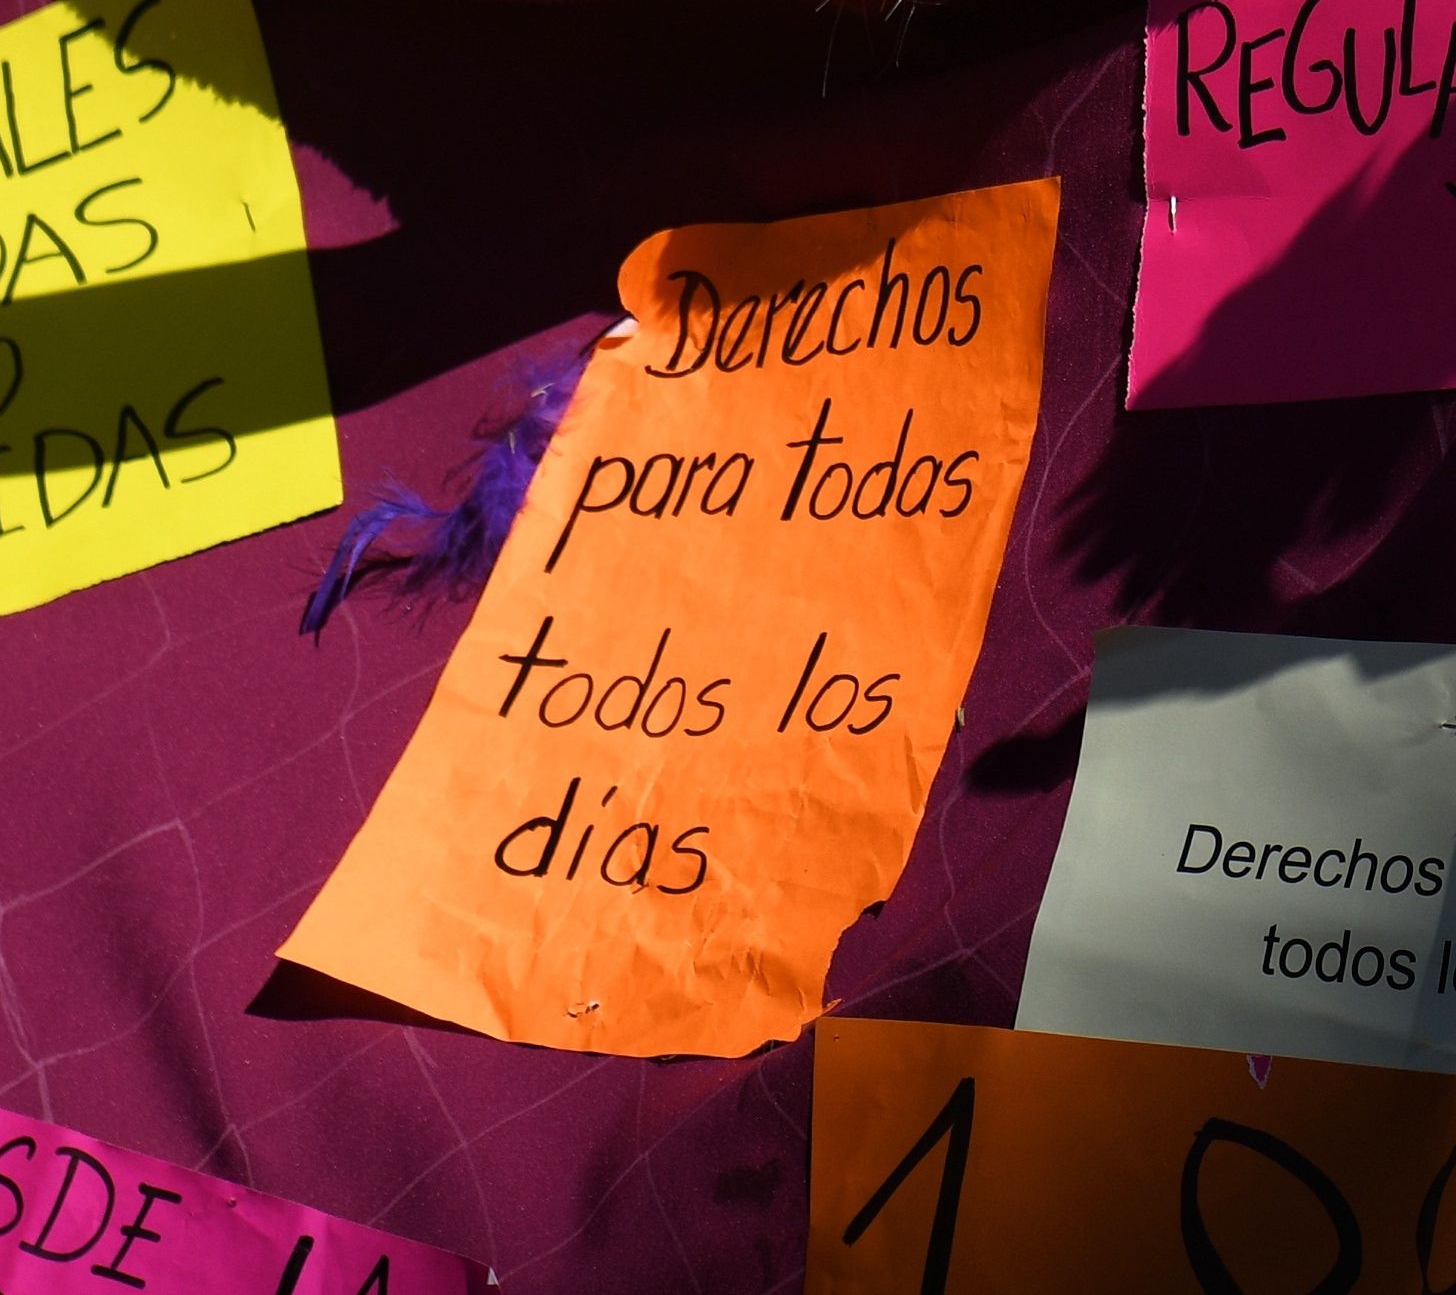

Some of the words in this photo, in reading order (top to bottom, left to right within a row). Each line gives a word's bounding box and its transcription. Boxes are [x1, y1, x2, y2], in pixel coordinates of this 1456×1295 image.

[645, 240, 984, 378] Derechos
[545, 451, 755, 574] para
[780, 398, 981, 522] todas
[497, 616, 732, 738] todos
[777, 632, 902, 735] los
[495, 778, 711, 896] días
[1175, 823, 1446, 897] Derechos
[1260, 923, 1418, 991] todos
